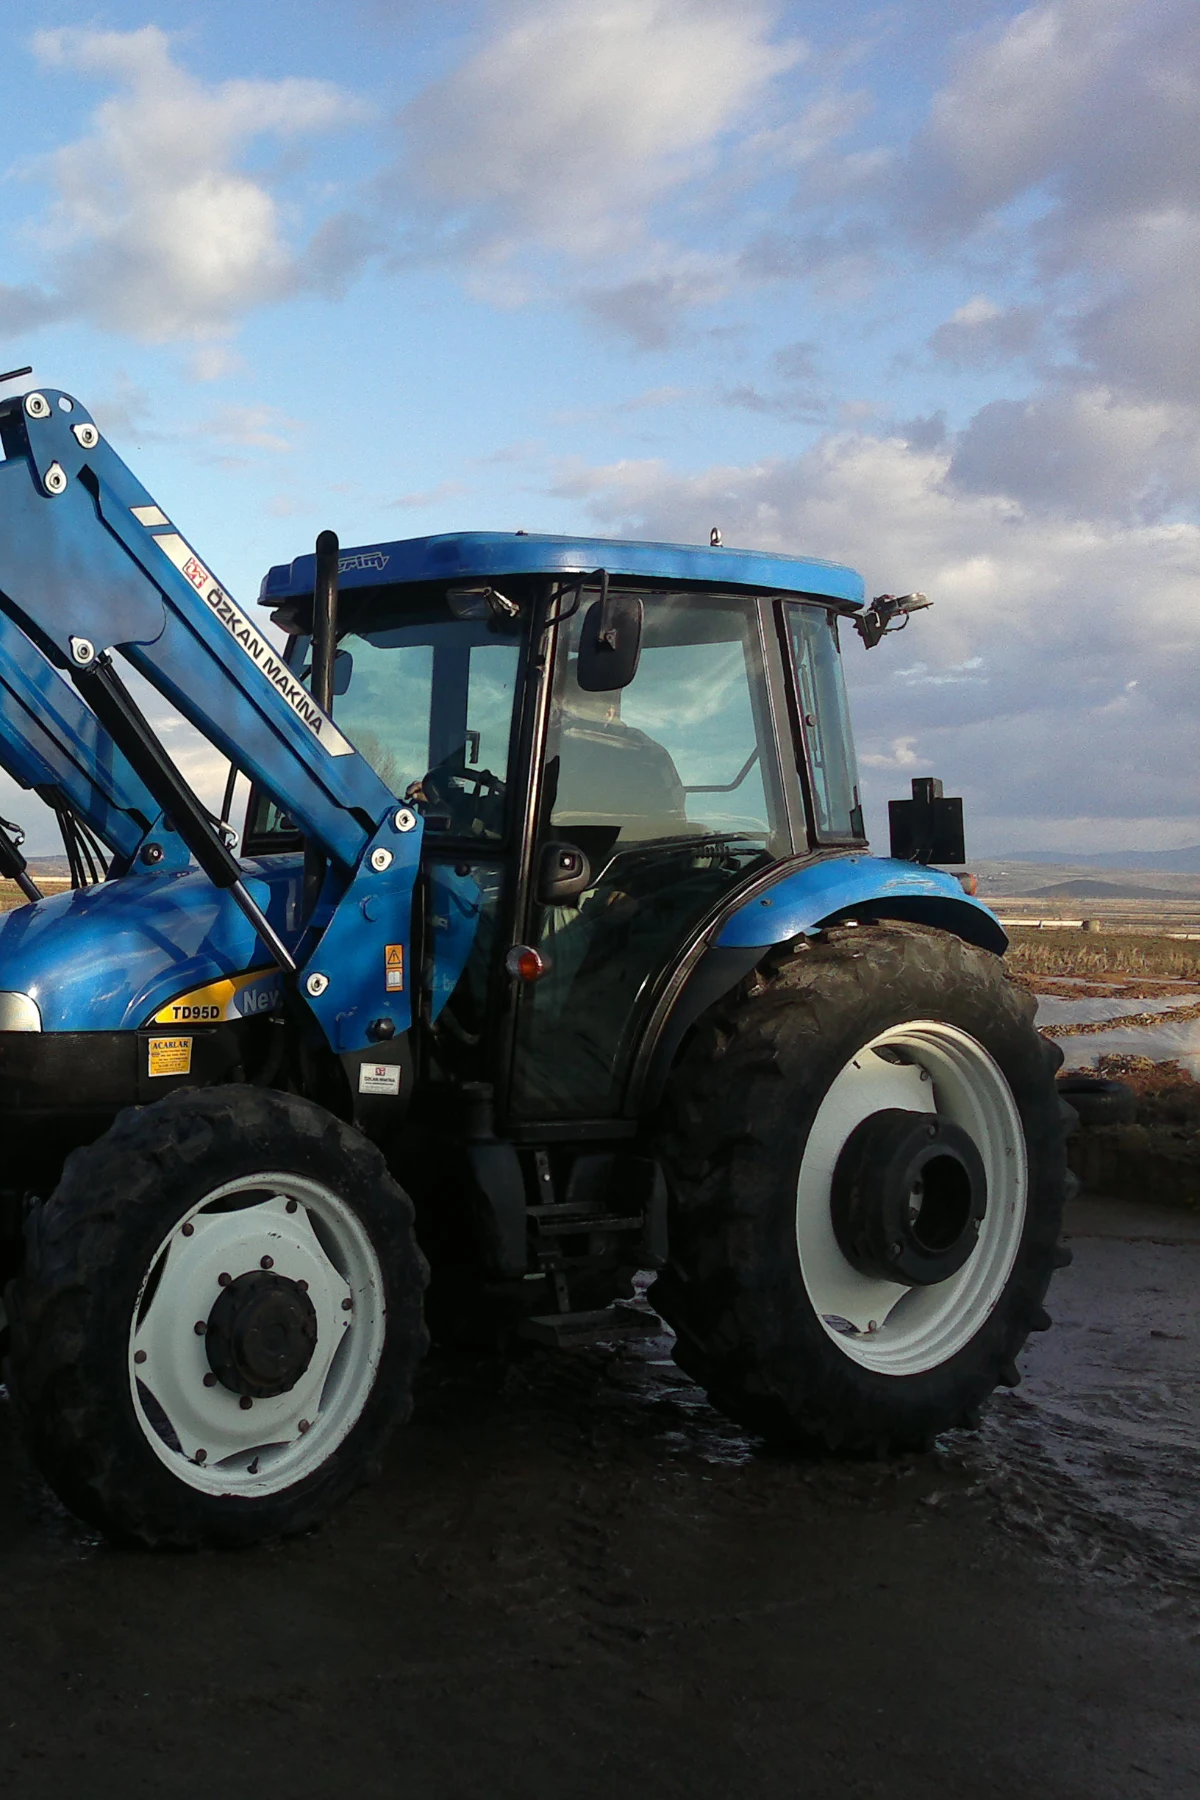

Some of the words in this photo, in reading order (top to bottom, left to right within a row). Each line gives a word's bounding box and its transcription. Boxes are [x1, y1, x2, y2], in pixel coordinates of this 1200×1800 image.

[206, 588, 264, 660] ÖZKAN
[262, 656, 323, 735] MAKİNA
[172, 1005, 220, 1020] TD95D
